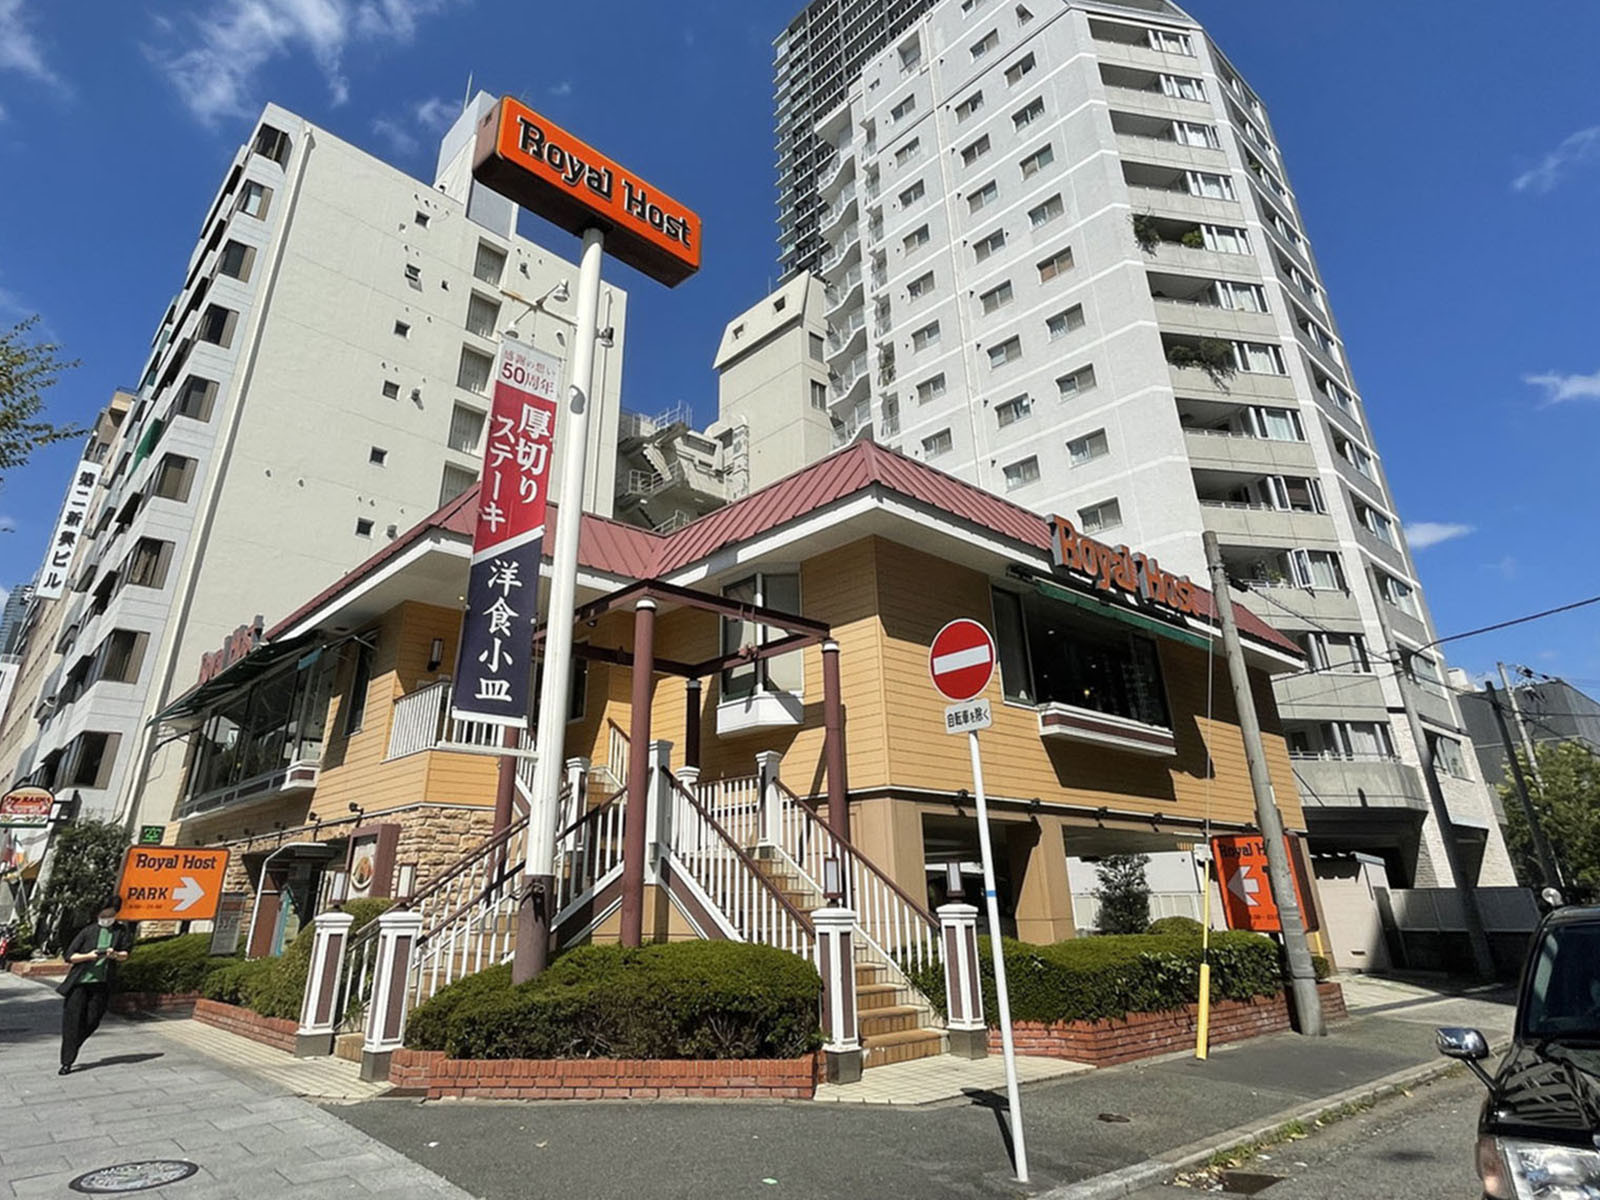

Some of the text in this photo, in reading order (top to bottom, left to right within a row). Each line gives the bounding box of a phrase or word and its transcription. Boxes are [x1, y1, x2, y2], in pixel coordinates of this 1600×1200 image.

[517, 115, 692, 248] Royal Host
[501, 362, 554, 395] 50周年
[482, 415, 515, 534] ステーキ
[516, 404, 552, 503] 厚切り
[1045, 514, 1139, 592] Royal
[475, 560, 522, 702] 洋食小皿
[946, 707, 990, 728] 自転車を除く
[128, 887, 168, 900] PARK
[136, 853, 217, 872] Royal Host
